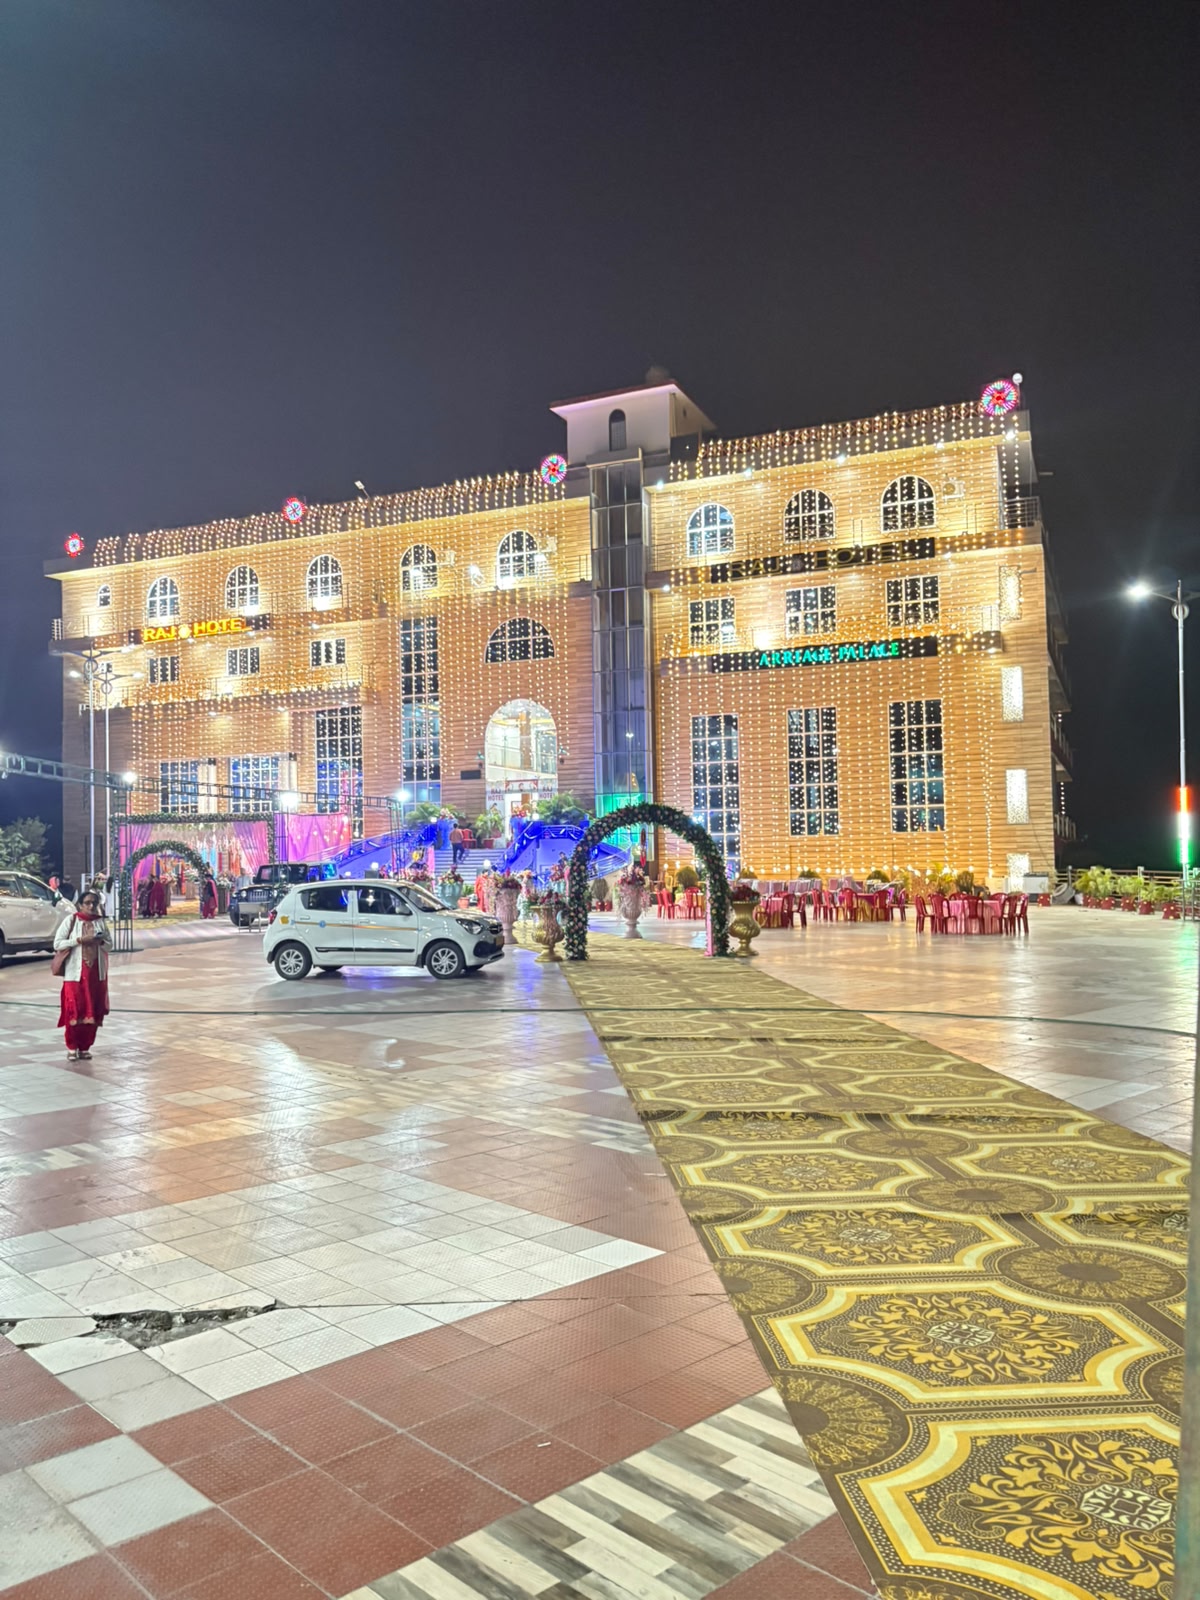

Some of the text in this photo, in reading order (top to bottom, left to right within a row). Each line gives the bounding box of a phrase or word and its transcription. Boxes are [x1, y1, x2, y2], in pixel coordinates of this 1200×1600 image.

[728, 543, 916, 578] RAJ HOTEL
[143, 625, 175, 642] RAJ
[838, 642, 900, 661] PALACE
